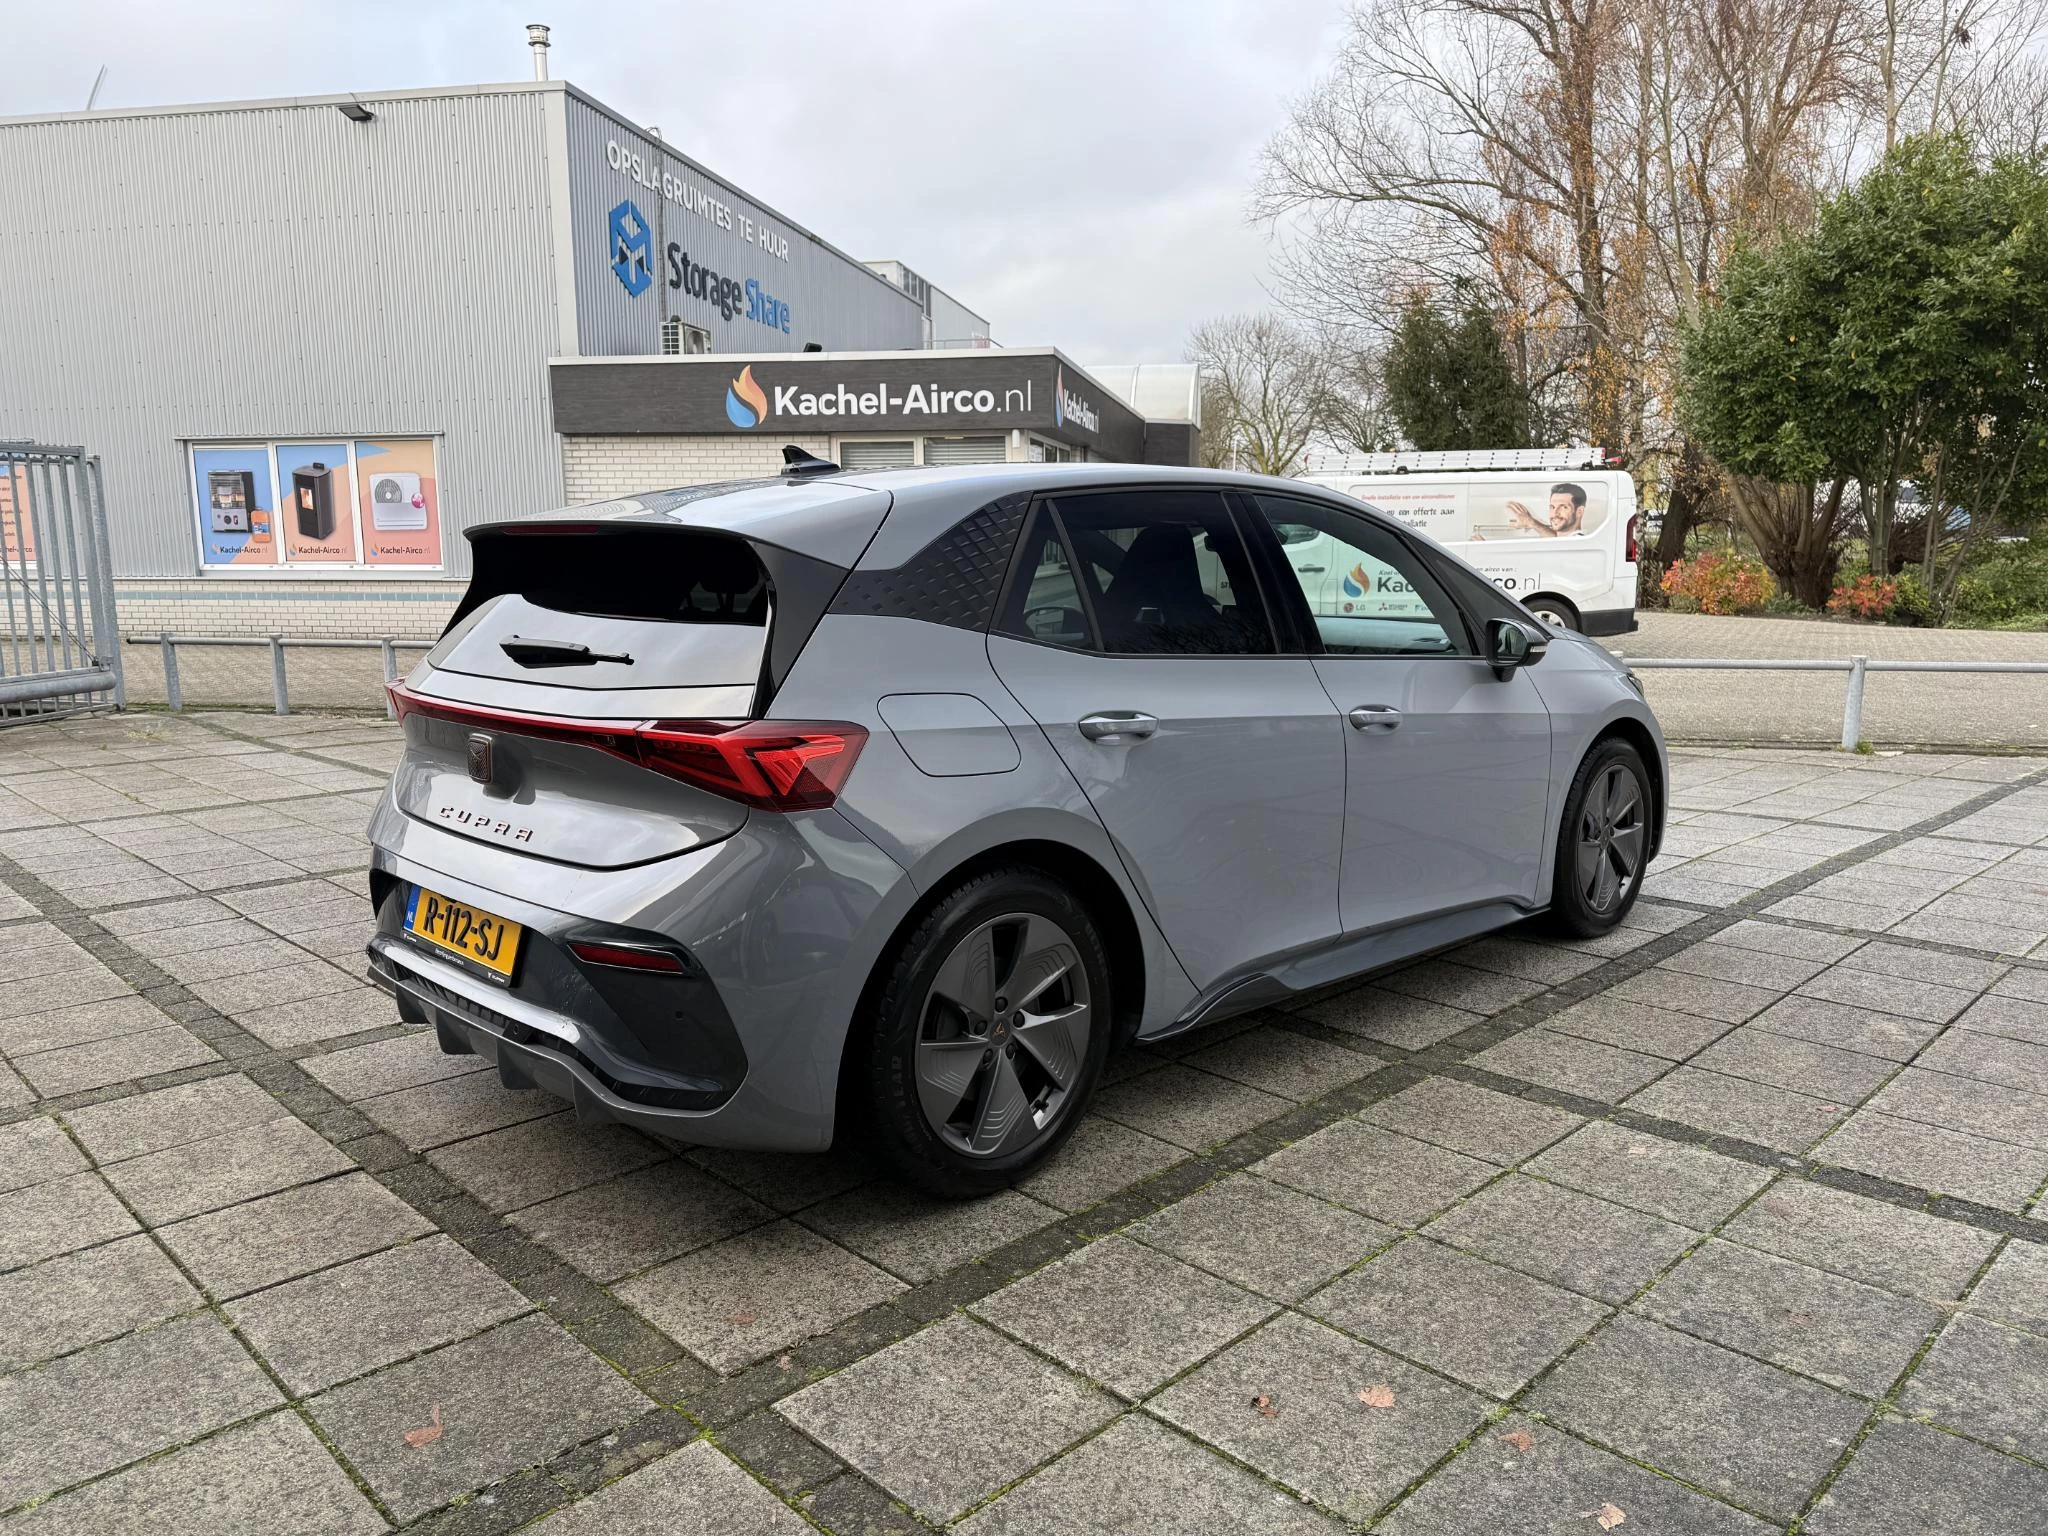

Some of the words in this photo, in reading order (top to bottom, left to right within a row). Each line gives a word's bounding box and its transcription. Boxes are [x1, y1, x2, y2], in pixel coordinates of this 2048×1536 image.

[606, 139, 731, 231] OPSLAGRUIMTES
[737, 214, 753, 243] TE
[759, 228, 788, 262] HUUR
[667, 242, 742, 321] Storage
[745, 278, 790, 334] Share
[774, 380, 1032, 417] Kachel-Airco.nl
[1413, 507, 1436, 516] offerte
[1440, 508, 1455, 516] aan
[440, 806, 534, 842] CUPRA
[406, 911, 414, 923] NL
[423, 896, 505, 961] R-112-SJ
